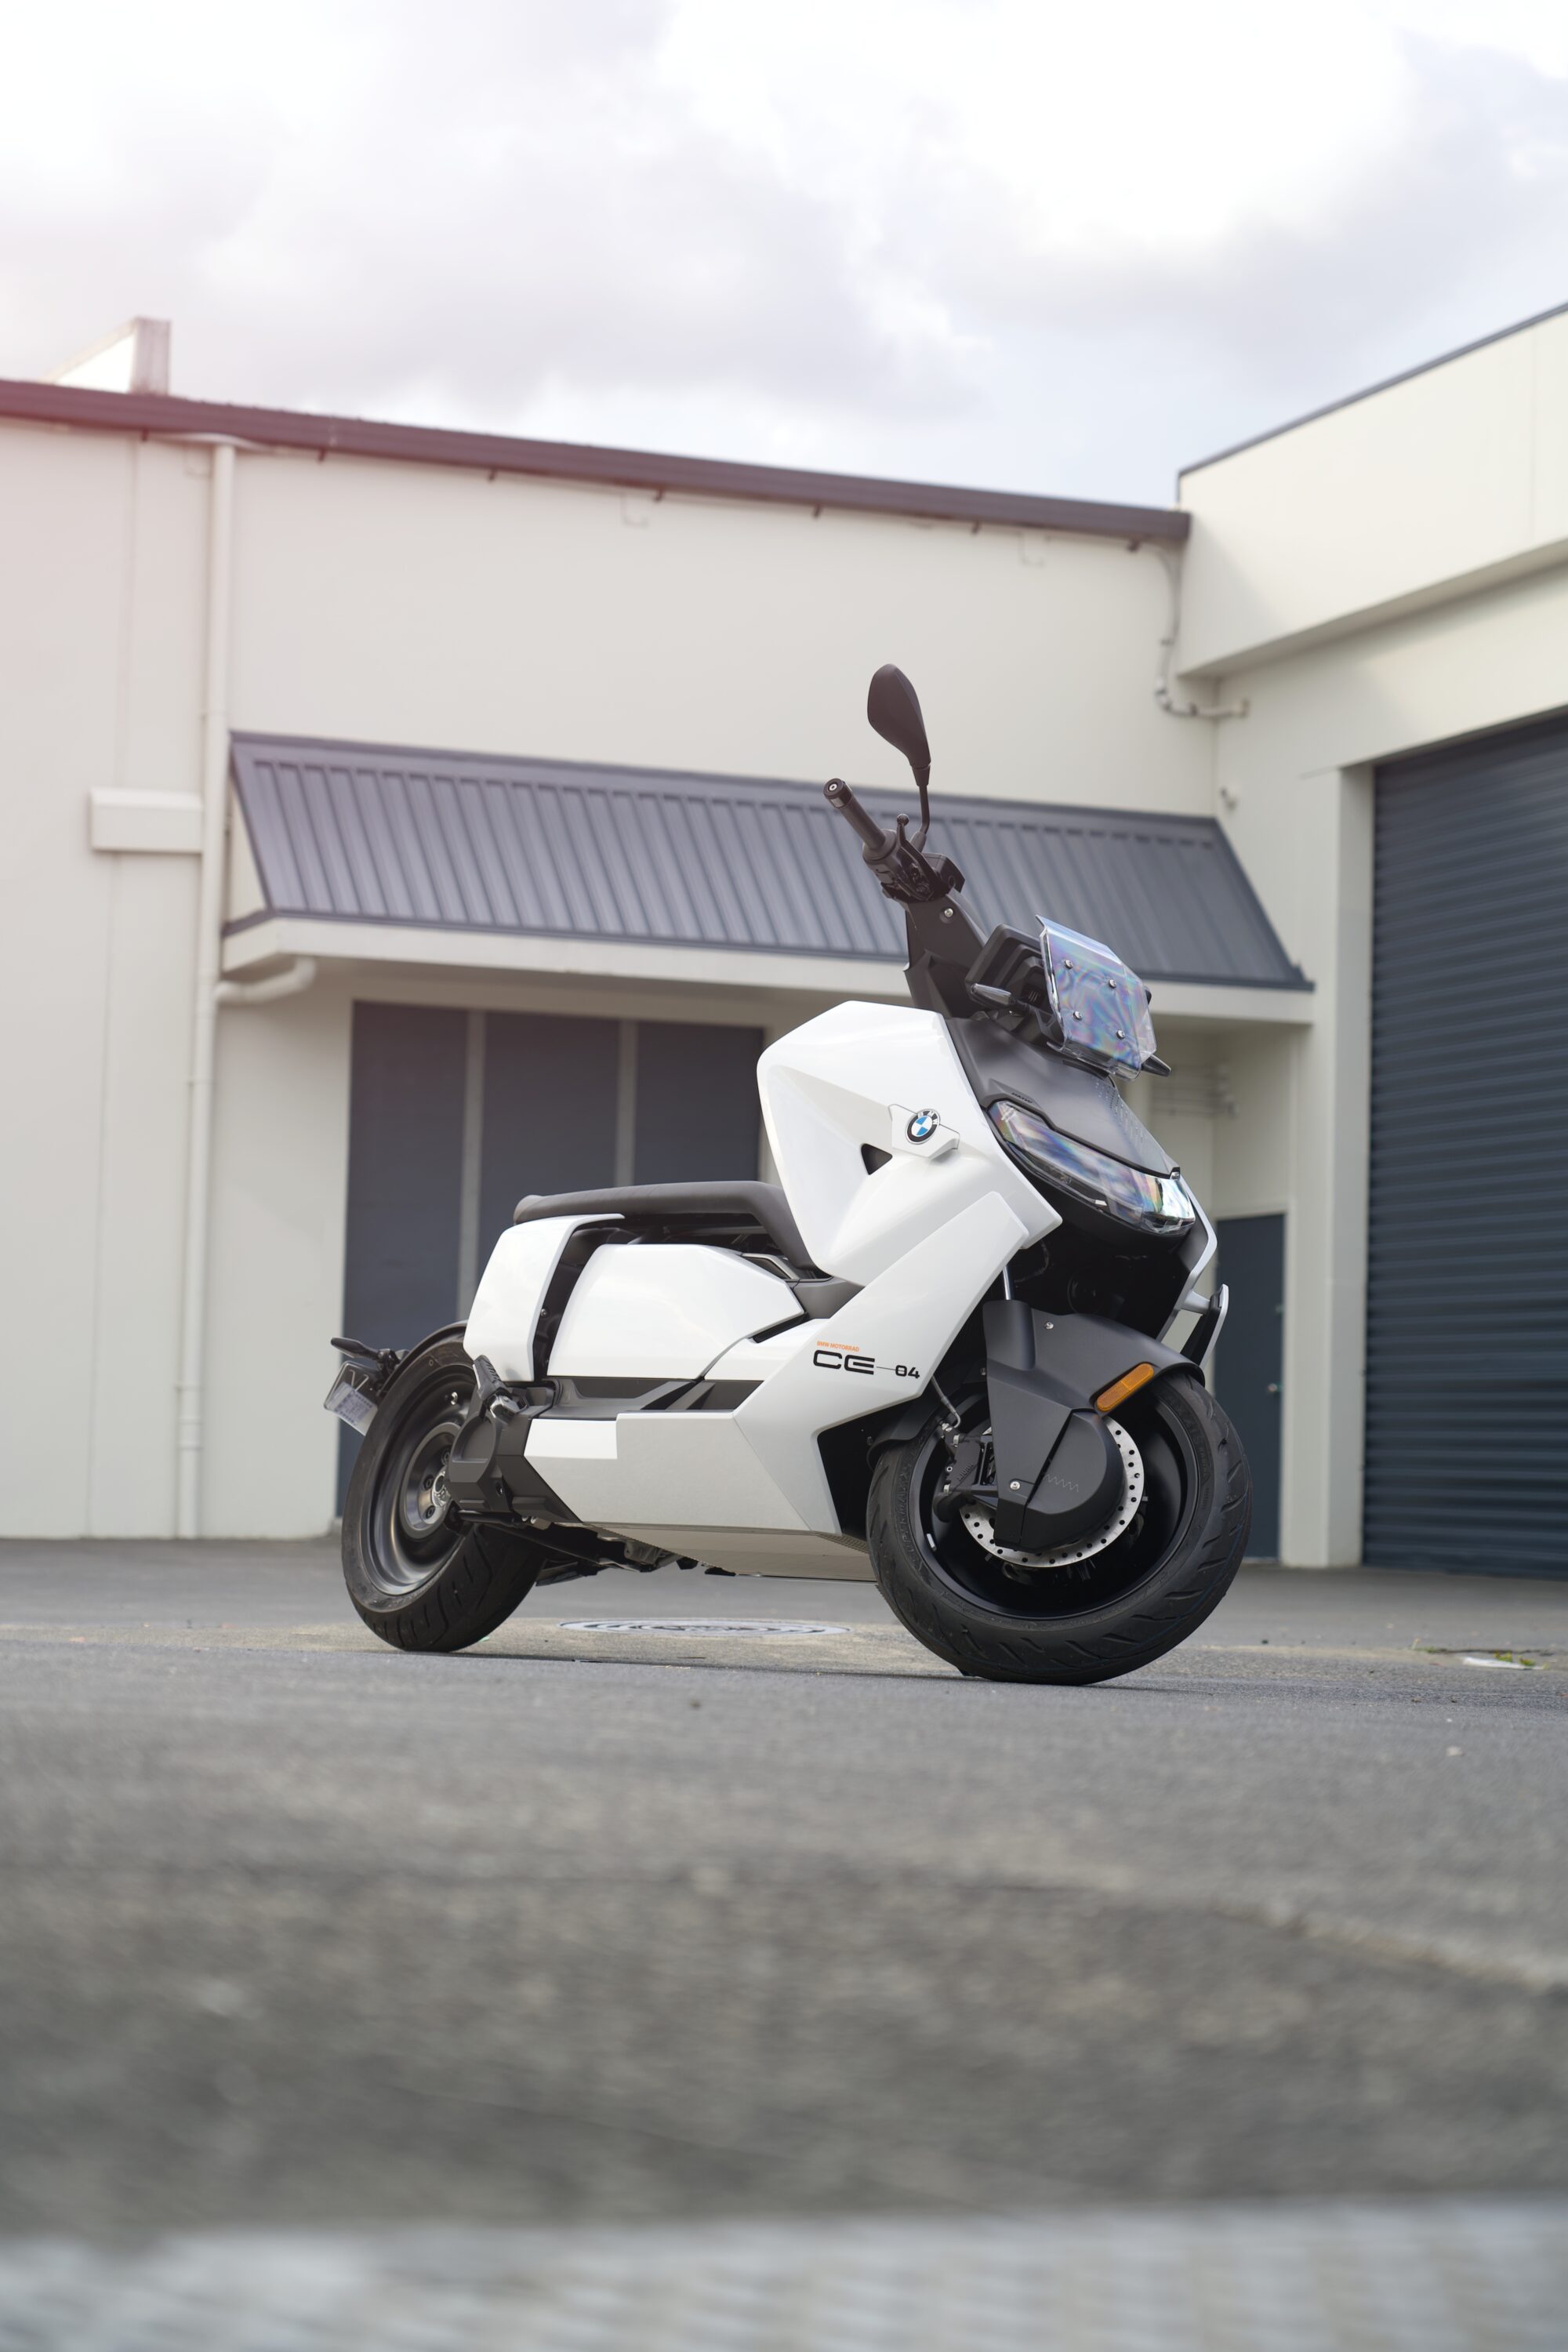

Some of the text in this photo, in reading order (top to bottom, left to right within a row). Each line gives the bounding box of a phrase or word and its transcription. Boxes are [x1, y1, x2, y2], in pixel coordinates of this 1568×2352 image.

[829, 1342, 860, 1352] MOTORRAD
[813, 1349, 920, 1379] CE 04
